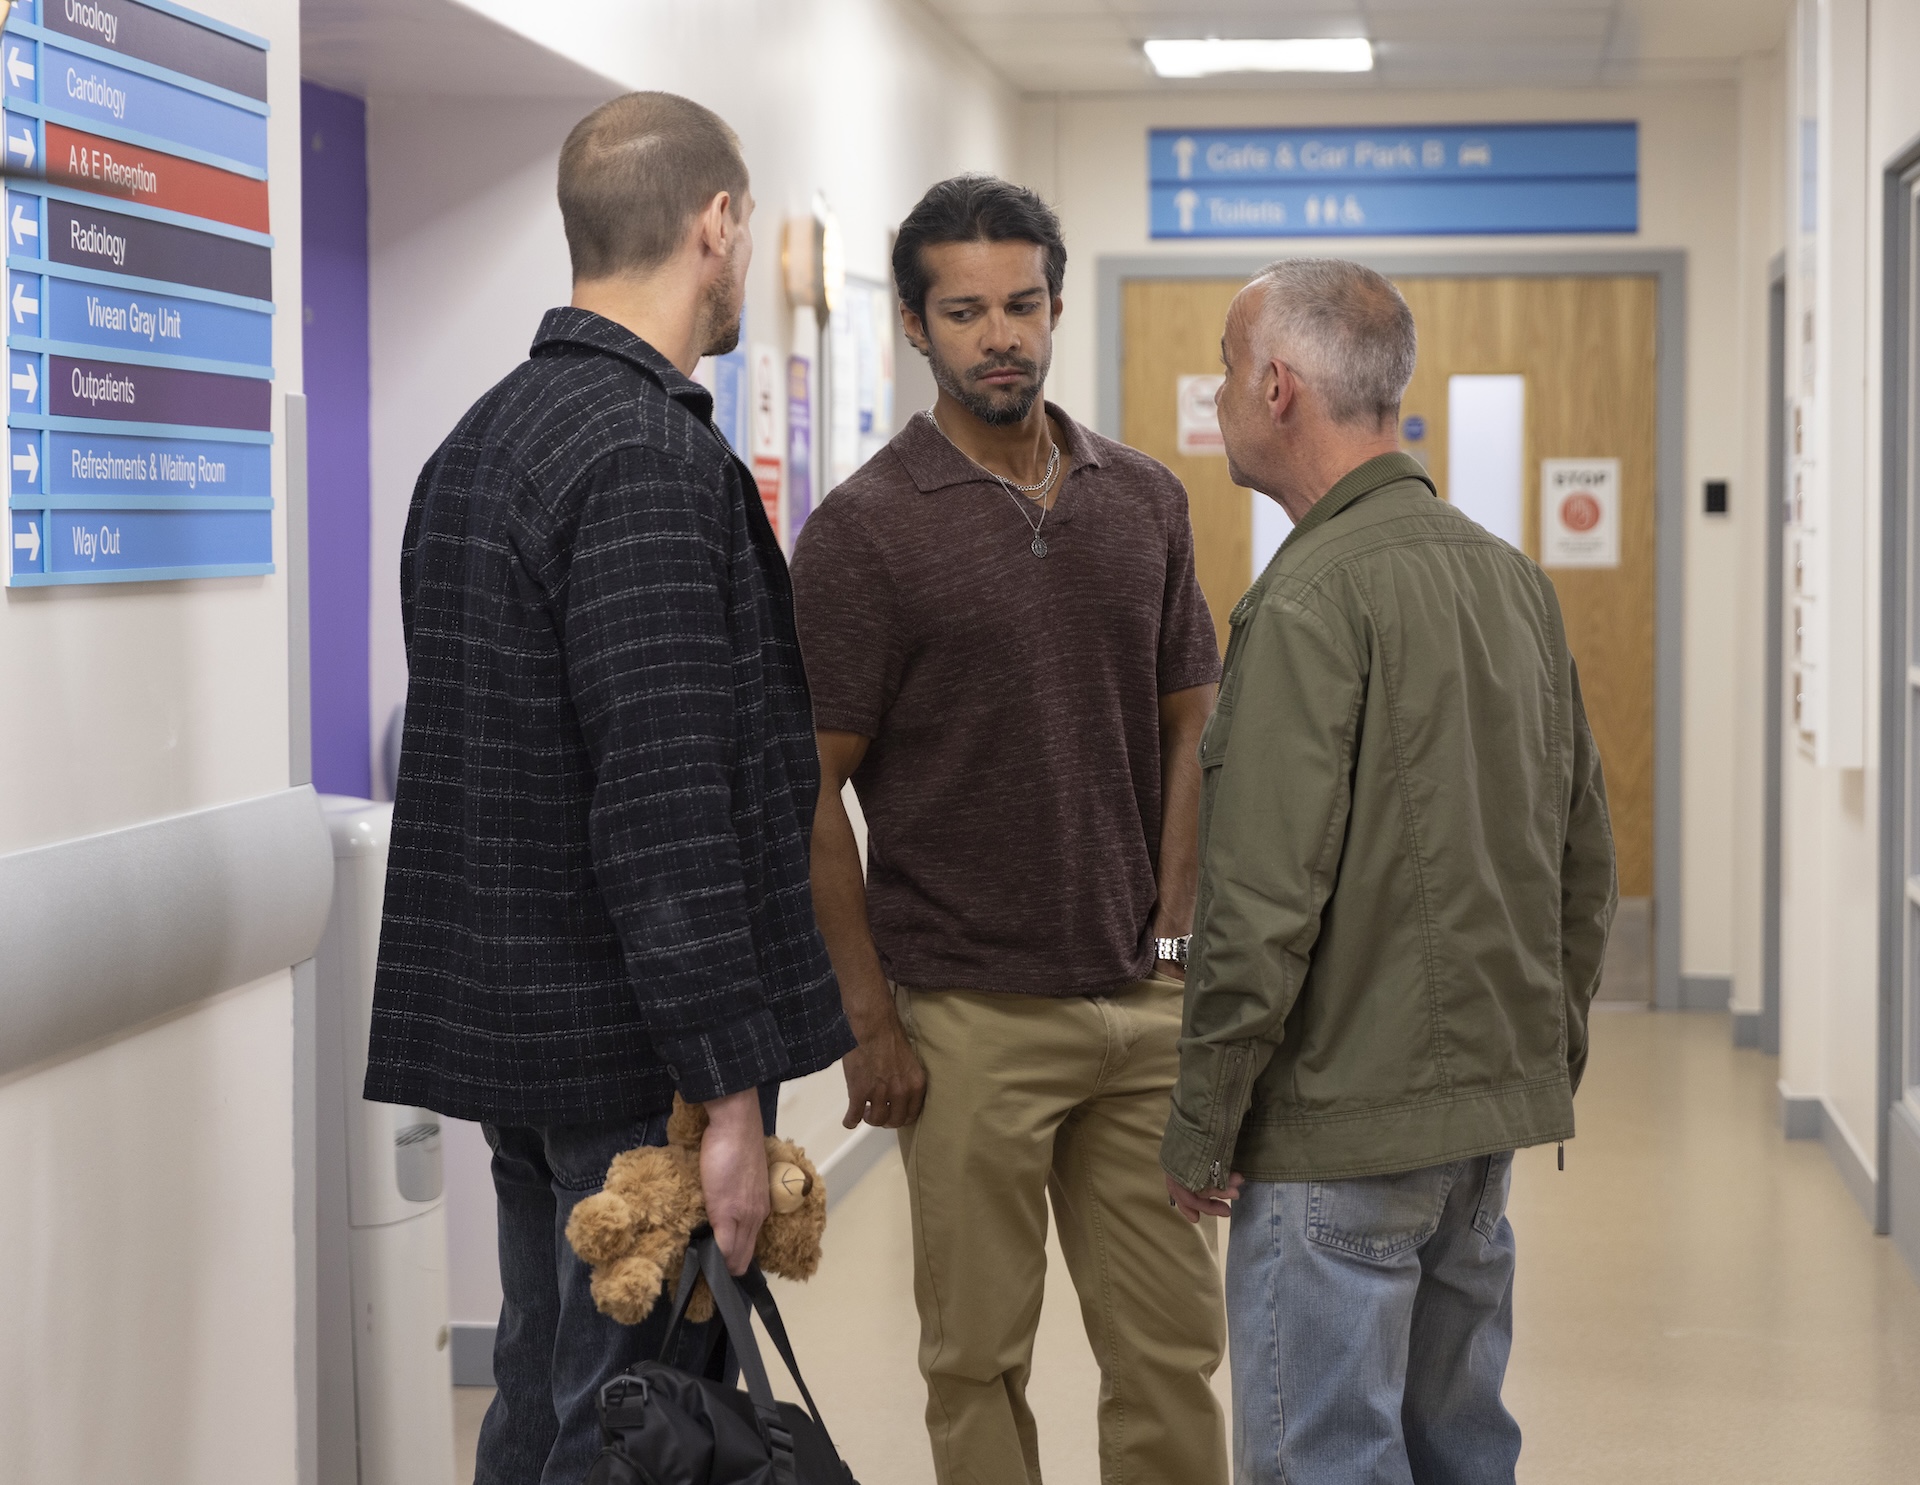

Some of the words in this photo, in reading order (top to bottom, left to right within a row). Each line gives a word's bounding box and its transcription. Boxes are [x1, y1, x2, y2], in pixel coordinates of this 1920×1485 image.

[65, 0, 117, 44] Oncology
[67, 68, 125, 118] Cardiology
[68, 144, 79, 175] A
[80, 147, 90, 177] &
[92, 149, 101, 180] E
[103, 152, 157, 195] Reception
[71, 220, 126, 265] Radiology
[87, 296, 126, 331] Vivean
[130, 302, 155, 342] Gray
[159, 307, 181, 339] Unit
[72, 367, 135, 406] Outpatients
[72, 449, 147, 481] Refreshments
[150, 452, 158, 481] &
[159, 453, 195, 489] Waiting
[198, 455, 225, 483] Room
[72, 526, 97, 562] Way
[100, 525, 120, 554] Out
